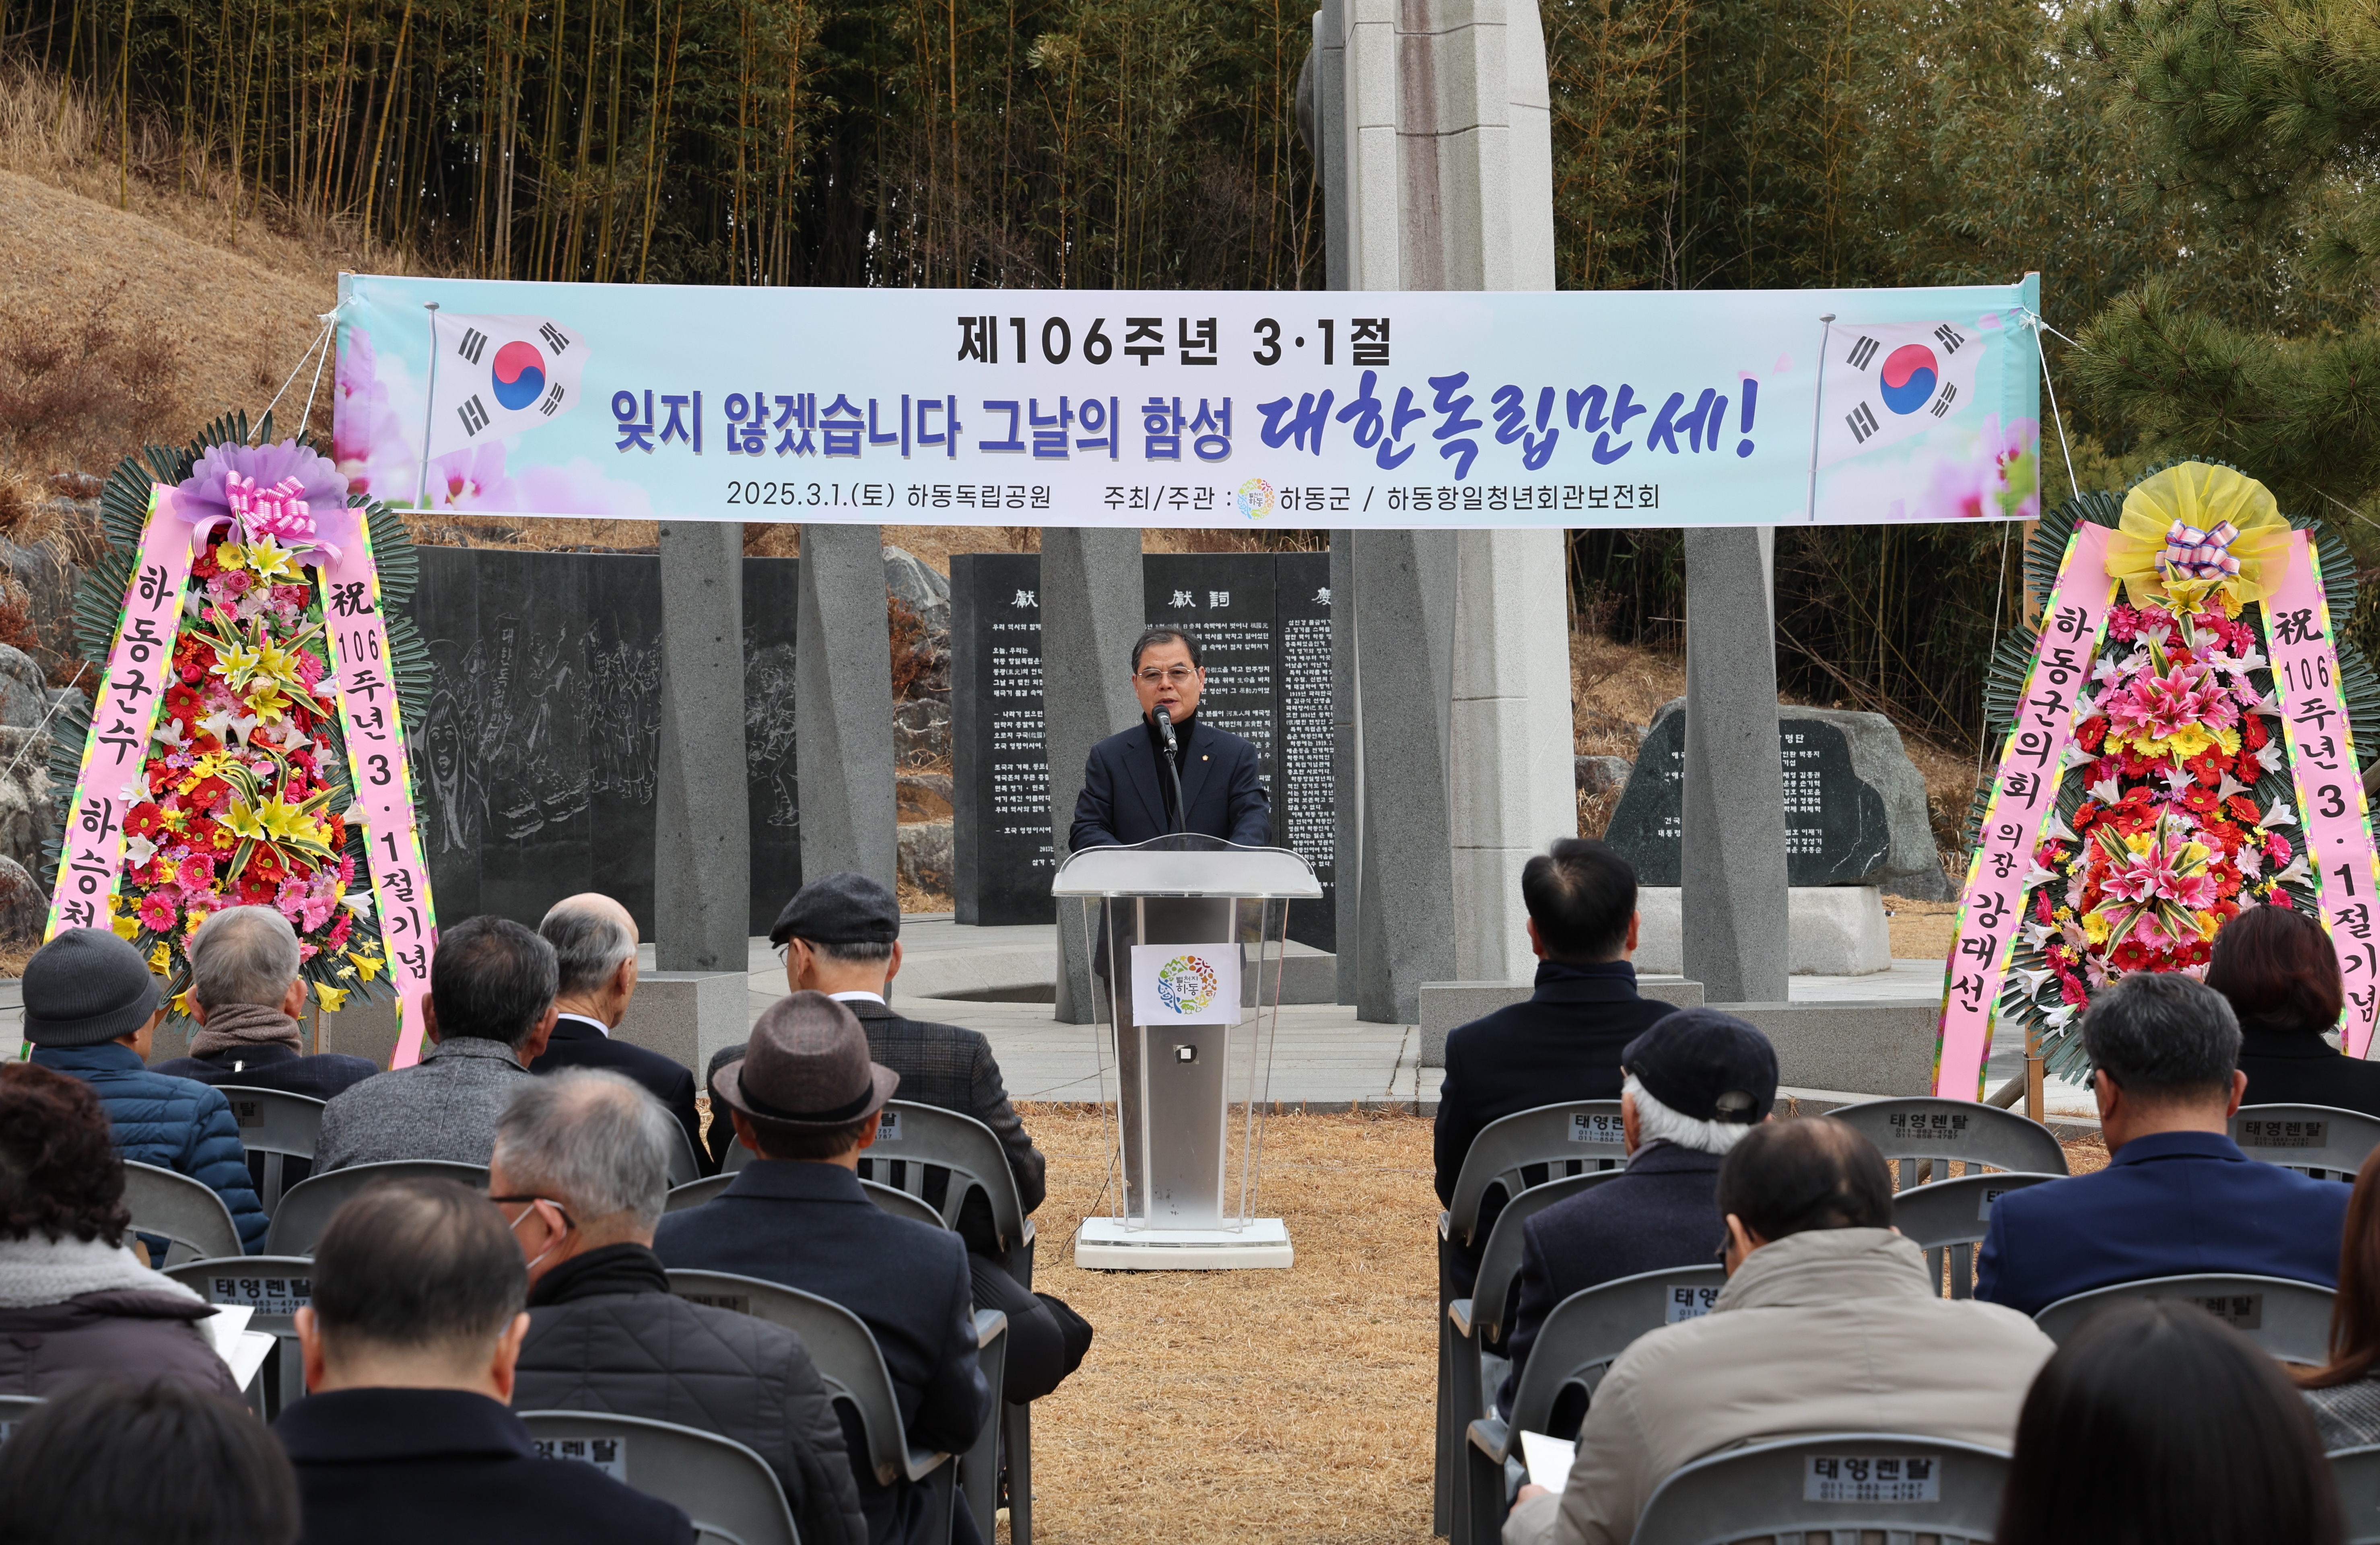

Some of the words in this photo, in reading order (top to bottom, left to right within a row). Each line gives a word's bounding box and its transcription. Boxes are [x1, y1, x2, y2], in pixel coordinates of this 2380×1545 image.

[958, 316, 1217, 366] 제106주년
[1253, 317, 1390, 366] 3·1절
[612, 390, 702, 453] 잊지
[725, 392, 962, 458] 않겠습니다
[979, 396, 1119, 459] 그날의
[1142, 397, 1232, 461] 함성
[1257, 370, 1758, 481] 대한독립만세!
[727, 481, 894, 507] 2025.3.1.(토)
[908, 484, 1050, 509] 하동독립공원
[1104, 486, 1214, 511] 주최/주관
[1281, 486, 1350, 511] 하동군
[1388, 484, 1658, 511] 하동항일청년회관보전회
[331, 582, 374, 616] 祝
[2275, 609, 2324, 644] 祝
[99, 565, 174, 765] 하동군수
[2003, 606, 2094, 809] 하동군의회
[1785, 734, 1804, 744] 명단
[1658, 829, 1681, 837] 대통령
[1990, 823, 2022, 879] 의장
[1951, 891, 2011, 1014] 강대선
[1176, 975, 1198, 983] 별천지
[1176, 984, 1199, 996] 하동
[1890, 1114, 1968, 1129] 태영렌탈
[2246, 1121, 2321, 1136] 태영렌탈
[215, 1279, 311, 1298] 태영렌탈
[1814, 1458, 1933, 1481] 태영렌탈
